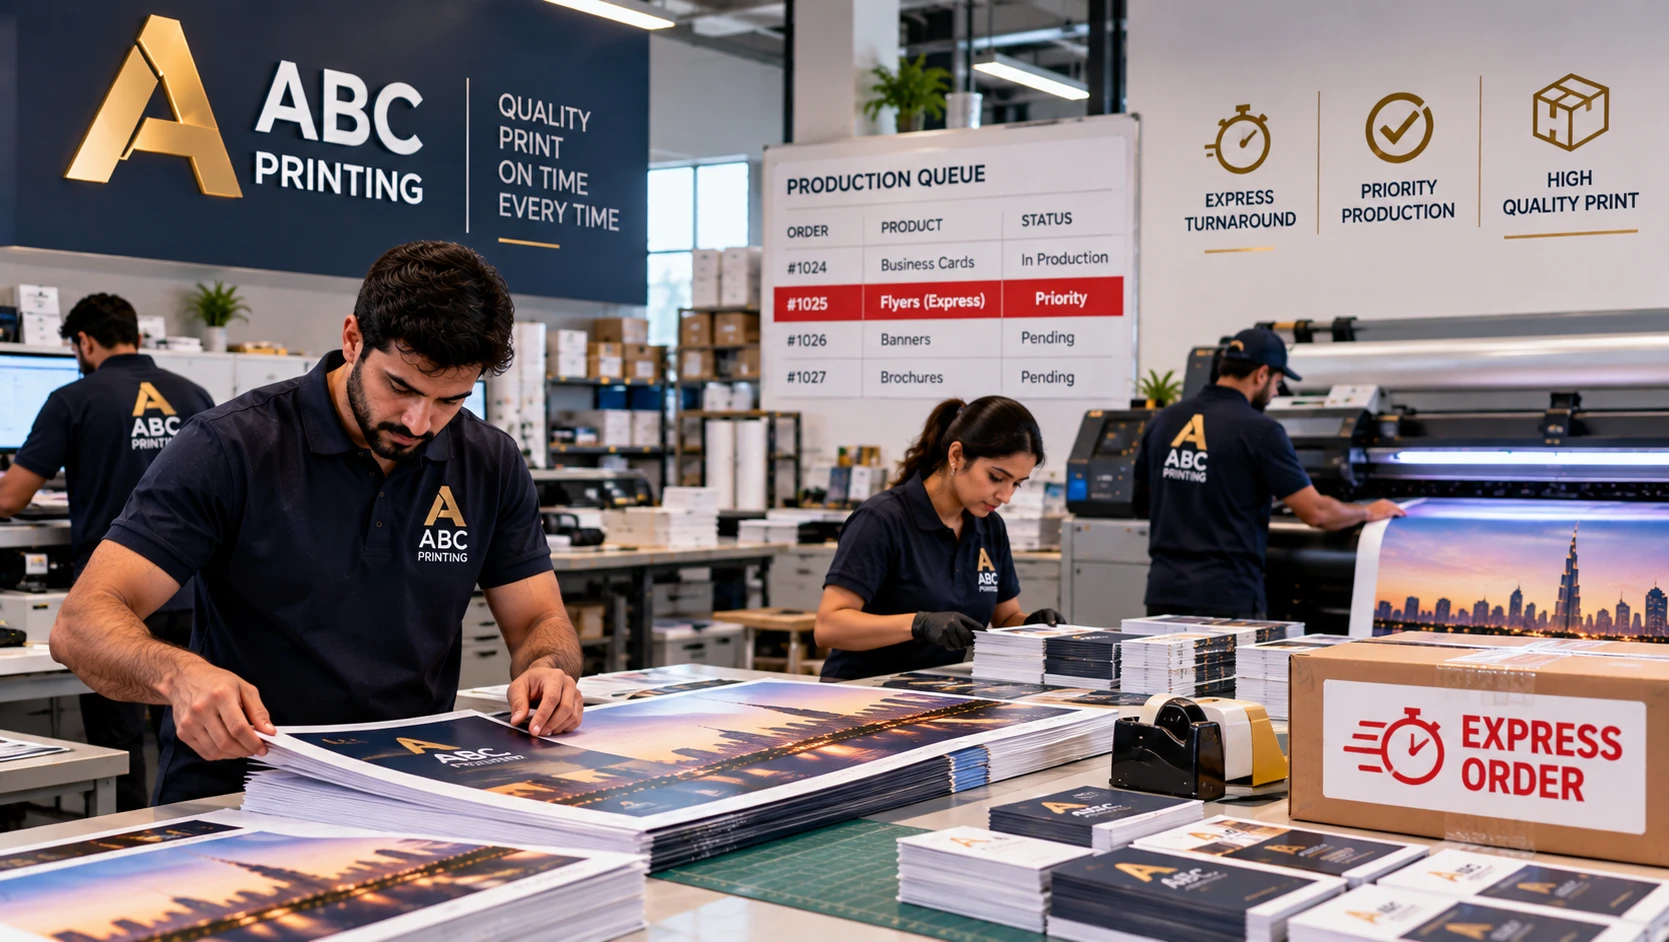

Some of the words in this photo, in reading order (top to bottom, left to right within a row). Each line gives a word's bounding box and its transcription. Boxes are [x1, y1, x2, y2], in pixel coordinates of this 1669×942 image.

[63, 14, 243, 198] A
[255, 60, 424, 155] ABC
[499, 93, 591, 132] QUALITY
[499, 126, 565, 160] PRINT
[255, 151, 424, 205] PRINTING
[499, 160, 532, 185] ON
[537, 166, 589, 196] TIME
[787, 170, 911, 195] PRODUCTION
[917, 164, 986, 187] QUEUE
[1547, 169, 1592, 188] HIGH
[1361, 179, 1438, 199] PRIORITY
[1205, 190, 1275, 208] EXPRESS
[1502, 195, 1579, 216] QUALITY
[1585, 191, 1640, 211] PRINT
[499, 193, 568, 224] EVERY
[573, 204, 620, 231] TIME
[1021, 211, 1073, 228] STATUS
[1342, 202, 1455, 224] PRODUCTION
[881, 218, 944, 234] PRODUCT
[1185, 211, 1297, 232] TURNAROUND
[786, 224, 829, 239] ORDER
[787, 260, 827, 275] #1024
[881, 258, 935, 272] Business
[938, 255, 975, 270] Cards
[1021, 253, 1033, 267] In
[1037, 250, 1109, 266] Production
[786, 296, 829, 312] #1025
[880, 294, 920, 312] Flyers
[923, 292, 986, 312] (Express)
[1035, 290, 1088, 308] Priority
[787, 333, 827, 347] #1026
[880, 332, 931, 346] Banners
[1021, 330, 1075, 348] Pending
[786, 370, 827, 384] #1027
[880, 370, 944, 384] Brochures
[1021, 370, 1075, 387] Pending
[131, 416, 181, 438] ABC
[131, 437, 172, 450] PRINTI
[1164, 448, 1208, 471] ABC
[1162, 467, 1207, 483] PRINTING
[423, 485, 467, 527] A
[419, 529, 468, 550] ABC
[418, 551, 468, 563] PRINTING
[978, 572, 998, 586] ABC
[1462, 714, 1623, 761] EXPRESS
[434, 748, 512, 764] ABC
[1461, 757, 1585, 802] ORDER
